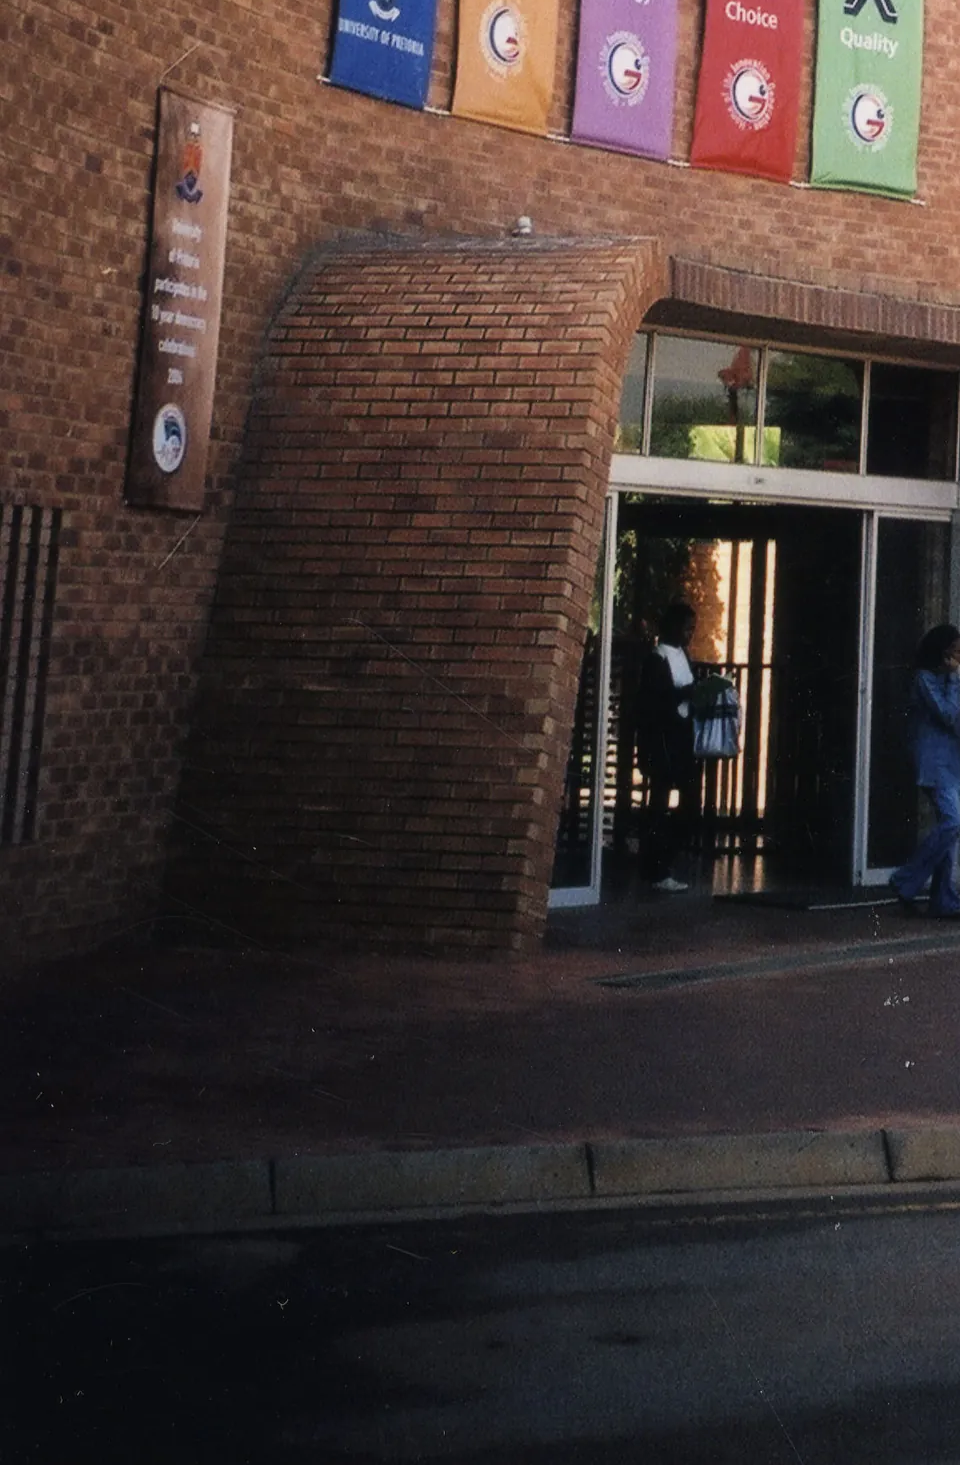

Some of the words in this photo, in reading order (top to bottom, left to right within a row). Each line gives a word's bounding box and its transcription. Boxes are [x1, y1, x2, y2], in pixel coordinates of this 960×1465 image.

[725, 1, 778, 29] Choice
[381, 30, 391, 46] OF
[840, 27, 898, 58] Quality
